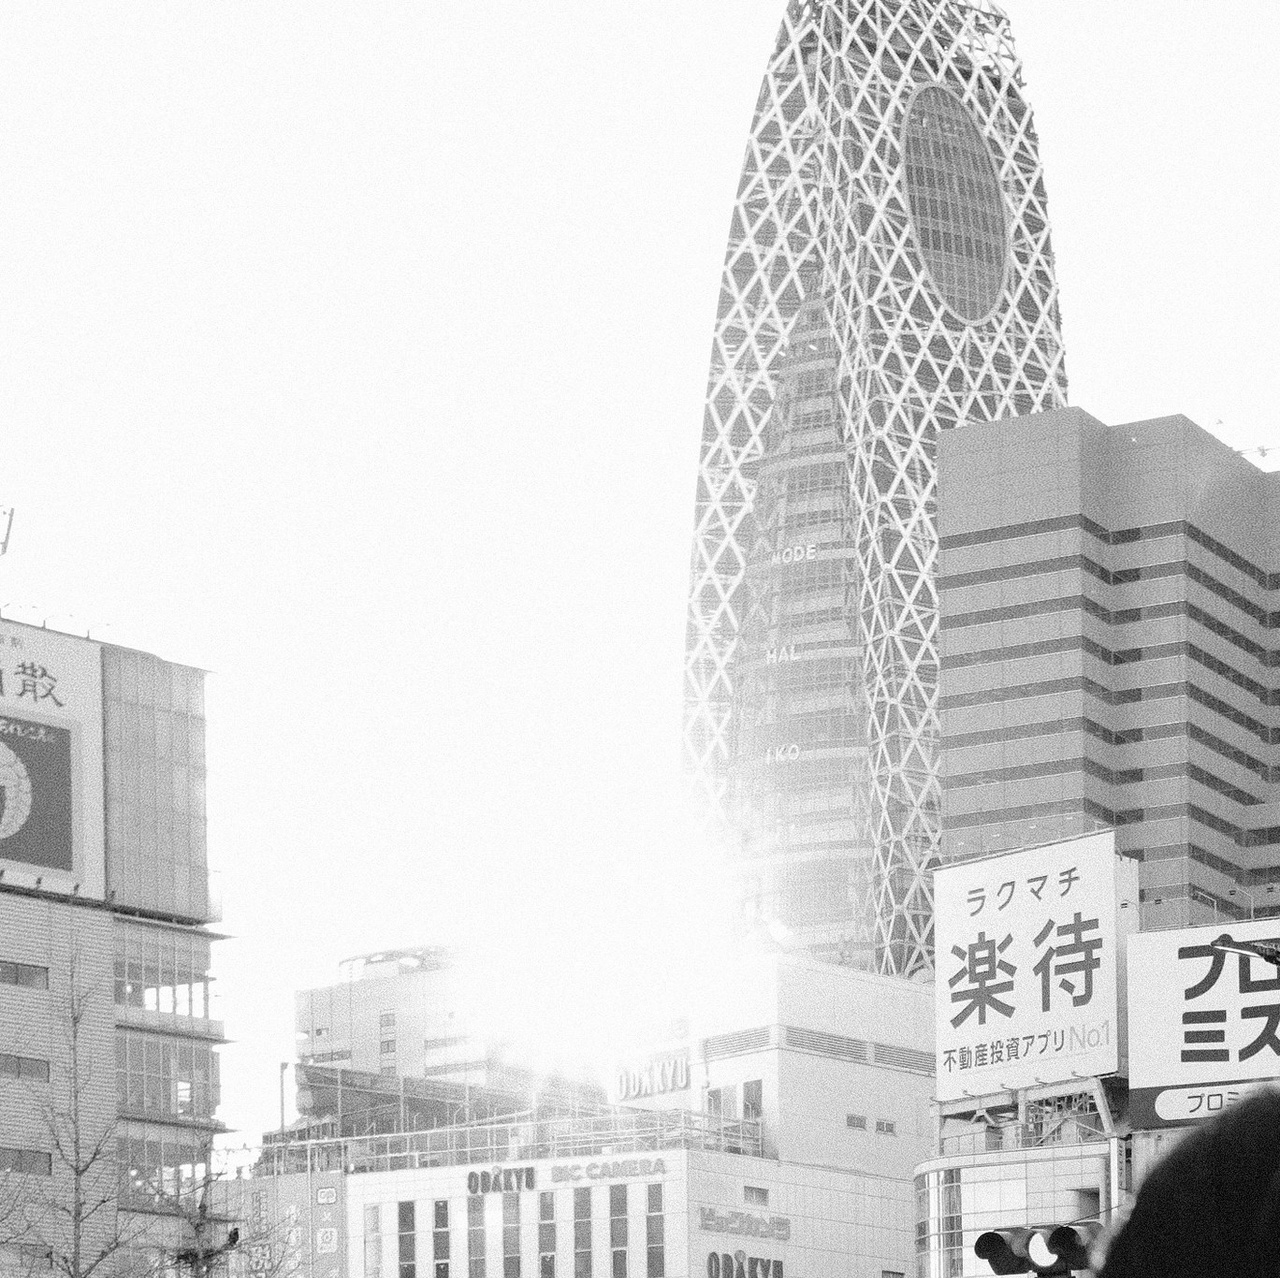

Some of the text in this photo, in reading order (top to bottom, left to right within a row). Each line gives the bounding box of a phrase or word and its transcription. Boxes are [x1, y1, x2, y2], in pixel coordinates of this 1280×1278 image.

[0, 658, 66, 708] 散
[966, 866, 1080, 917] ラクマチ
[948, 911, 1103, 1029] 楽待
[943, 1030, 1065, 1073] 不動産投資アプリ
[467, 1165, 536, 1195] ODAKYU
